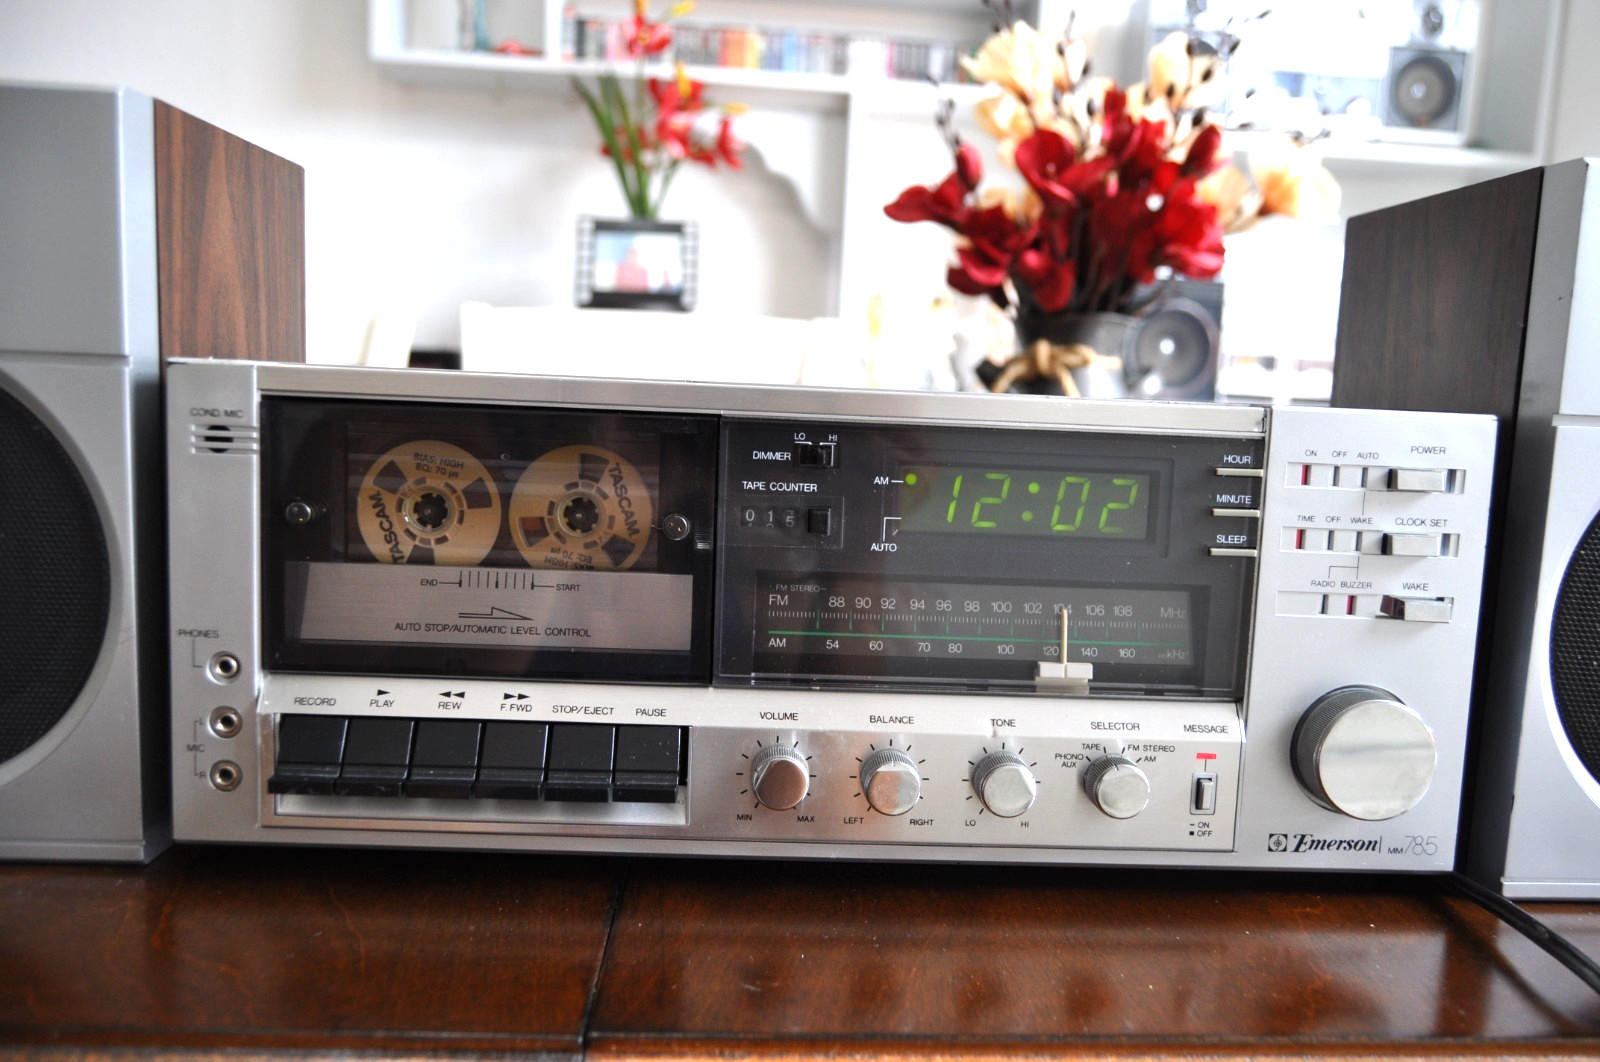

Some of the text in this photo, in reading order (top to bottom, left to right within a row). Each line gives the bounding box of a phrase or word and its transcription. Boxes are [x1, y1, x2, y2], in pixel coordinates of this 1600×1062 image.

[224, 408, 244, 419] MIC
[794, 432, 806, 441] LO
[828, 434, 838, 442] HI
[1304, 449, 1318, 458] ON
[1331, 450, 1348, 459] OFF
[1410, 445, 1447, 456] POWER
[752, 450, 792, 461] DIMMER
[1223, 454, 1252, 465] HOUR
[1357, 452, 1380, 461] AUTO
[439, 456, 465, 470] HIGH
[415, 462, 433, 474] EQ:
[434, 466, 448, 477] 70
[873, 476, 889, 485] AM
[742, 480, 818, 492] TAPE COUNTER
[607, 462, 642, 539] TASCAM
[946, 472, 1138, 533] 12:02
[1216, 494, 1252, 505] MINUTE
[1297, 514, 1316, 523] TIME
[1325, 515, 1341, 524] OFF
[1350, 517, 1374, 525] WAKE
[1395, 517, 1449, 528] CLOCK SET
[1216, 534, 1247, 544] SLEEP
[870, 542, 898, 552] AUTO
[420, 578, 438, 587] END
[1310, 579, 1373, 590] RADIO BUZZER
[1402, 582, 1429, 592] WAKE
[555, 583, 581, 592] START
[789, 584, 821, 593] STEREO
[768, 594, 789, 606] FM
[828, 596, 846, 608] 88
[855, 597, 872, 609] 90
[880, 598, 896, 610] 92
[909, 599, 925, 610] 94
[935, 600, 952, 611] 96
[963, 600, 980, 612] 98
[990, 601, 1013, 613] 100
[1023, 602, 1043, 614] 102
[1085, 604, 1105, 616] 106
[1113, 605, 1133, 617] 108
[1160, 606, 1187, 618] MHz
[178, 628, 220, 639] PHONES
[394, 622, 592, 638] AUTO STOP/AUTOMATIC LEVEL CONTROL
[768, 637, 786, 648] AM
[826, 639, 840, 649] 54
[869, 641, 884, 651] 60
[918, 641, 931, 653] 70
[948, 643, 963, 653] 80
[997, 645, 1015, 655] 100
[1043, 646, 1060, 656] 120
[1081, 647, 1098, 658] 140
[1119, 648, 1136, 658] 160
[293, 697, 337, 706] RECORD
[369, 699, 396, 708] PLAY
[438, 701, 462, 710] REW
[552, 705, 615, 716] STOP/EJECT
[635, 708, 667, 717] PAUSE
[759, 711, 799, 721] VOLUME
[869, 715, 915, 725] BALANCE
[991, 718, 1016, 728] TONE
[1090, 721, 1140, 731] SELECTOR
[1183, 724, 1229, 734] MESSAGE
[187, 743, 206, 753] MIC
[1081, 743, 1101, 751] TAPE
[1127, 744, 1176, 753] FM STEREO
[1054, 753, 1084, 761] PHONO
[1061, 761, 1077, 769] AUX
[736, 813, 753, 821] MIN
[796, 816, 816, 824] MAX
[843, 817, 864, 825] LEFT
[909, 819, 934, 827] RIGHT
[964, 819, 977, 828] LO
[1020, 820, 1030, 829] HI
[1197, 821, 1210, 829] ON
[1197, 830, 1213, 838] OFF
[1290, 833, 1379, 854] Emerson
